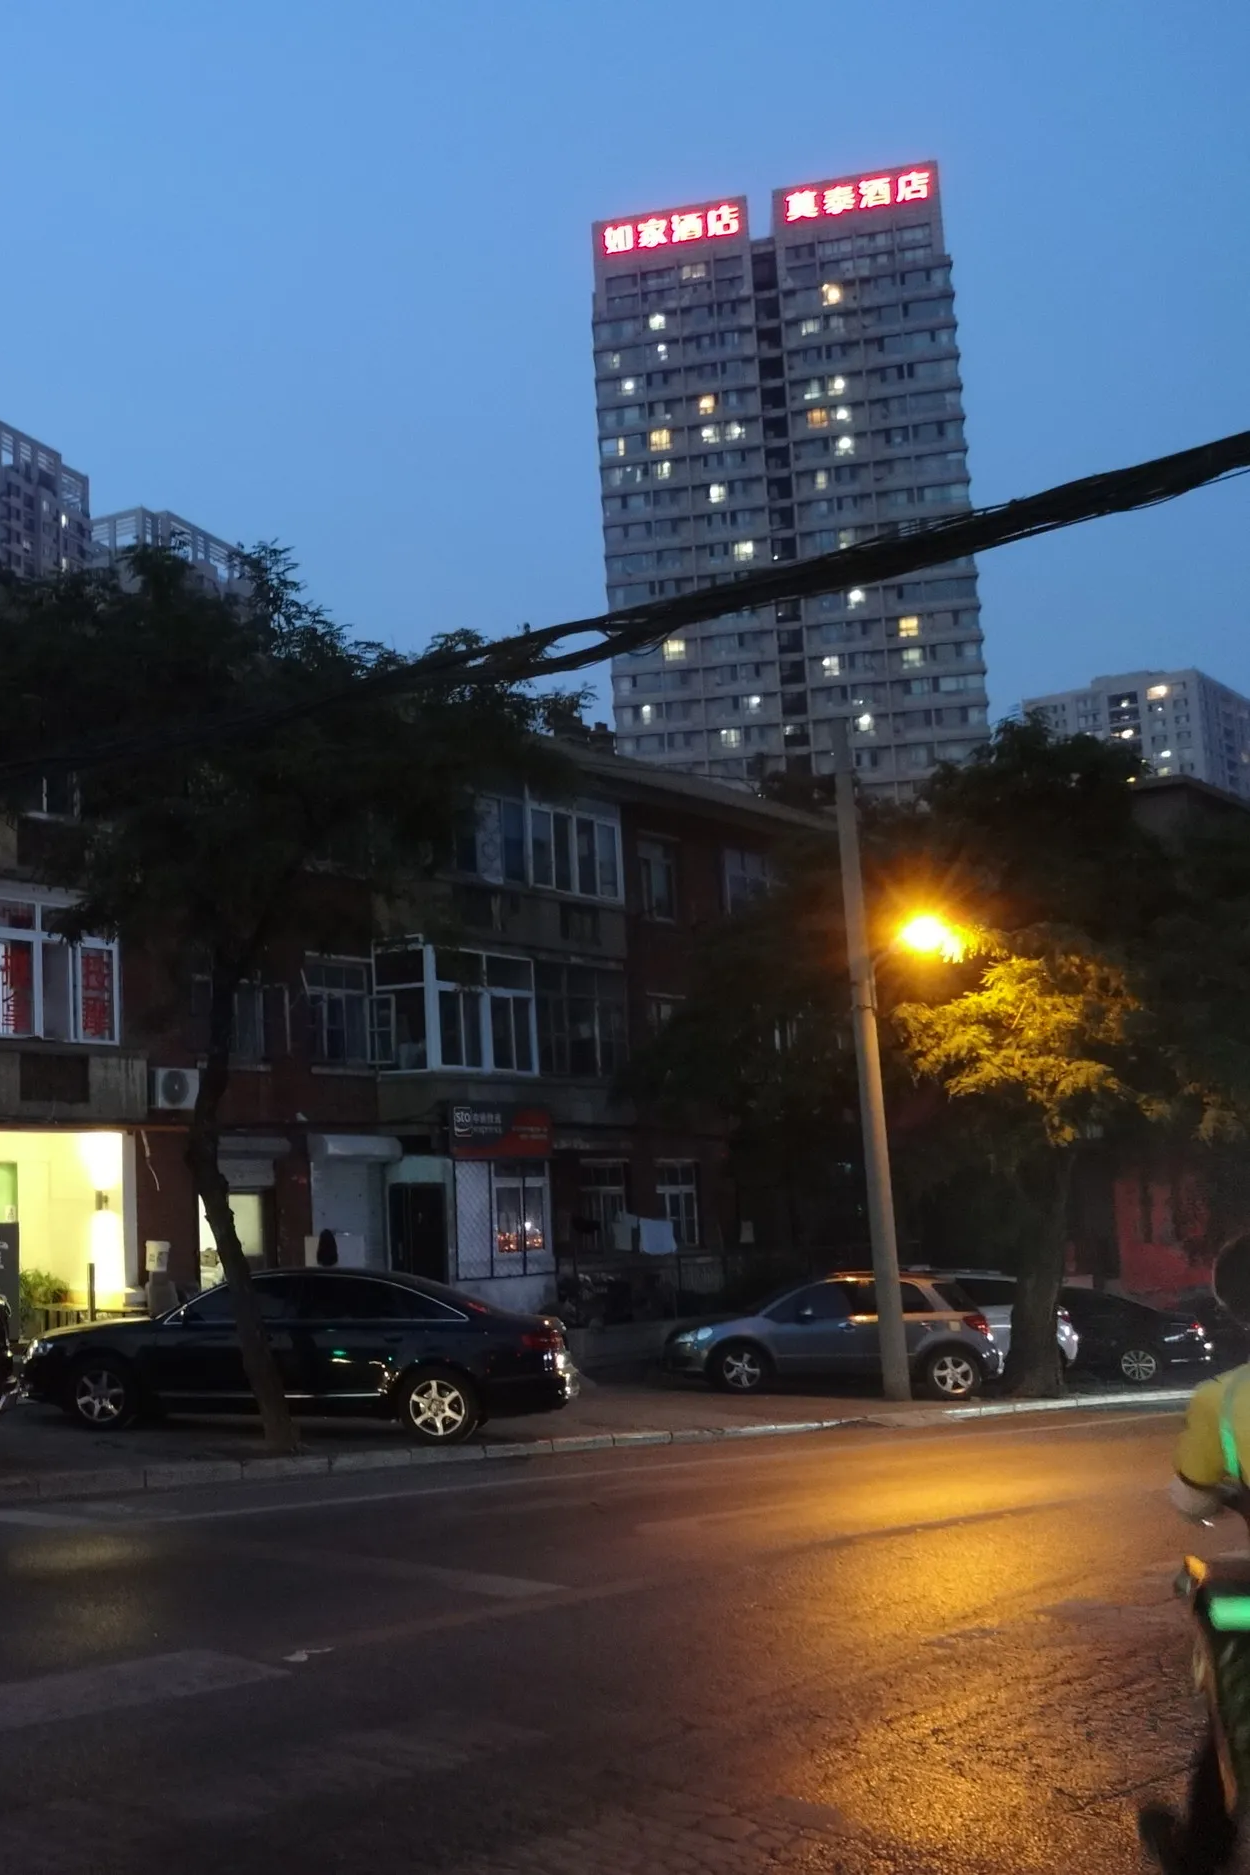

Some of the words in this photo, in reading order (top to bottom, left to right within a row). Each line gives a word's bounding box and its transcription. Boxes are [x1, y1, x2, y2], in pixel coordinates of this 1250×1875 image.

[785, 171, 930, 222] 莫泰酒店
[603, 205, 740, 254] 如家酒店
